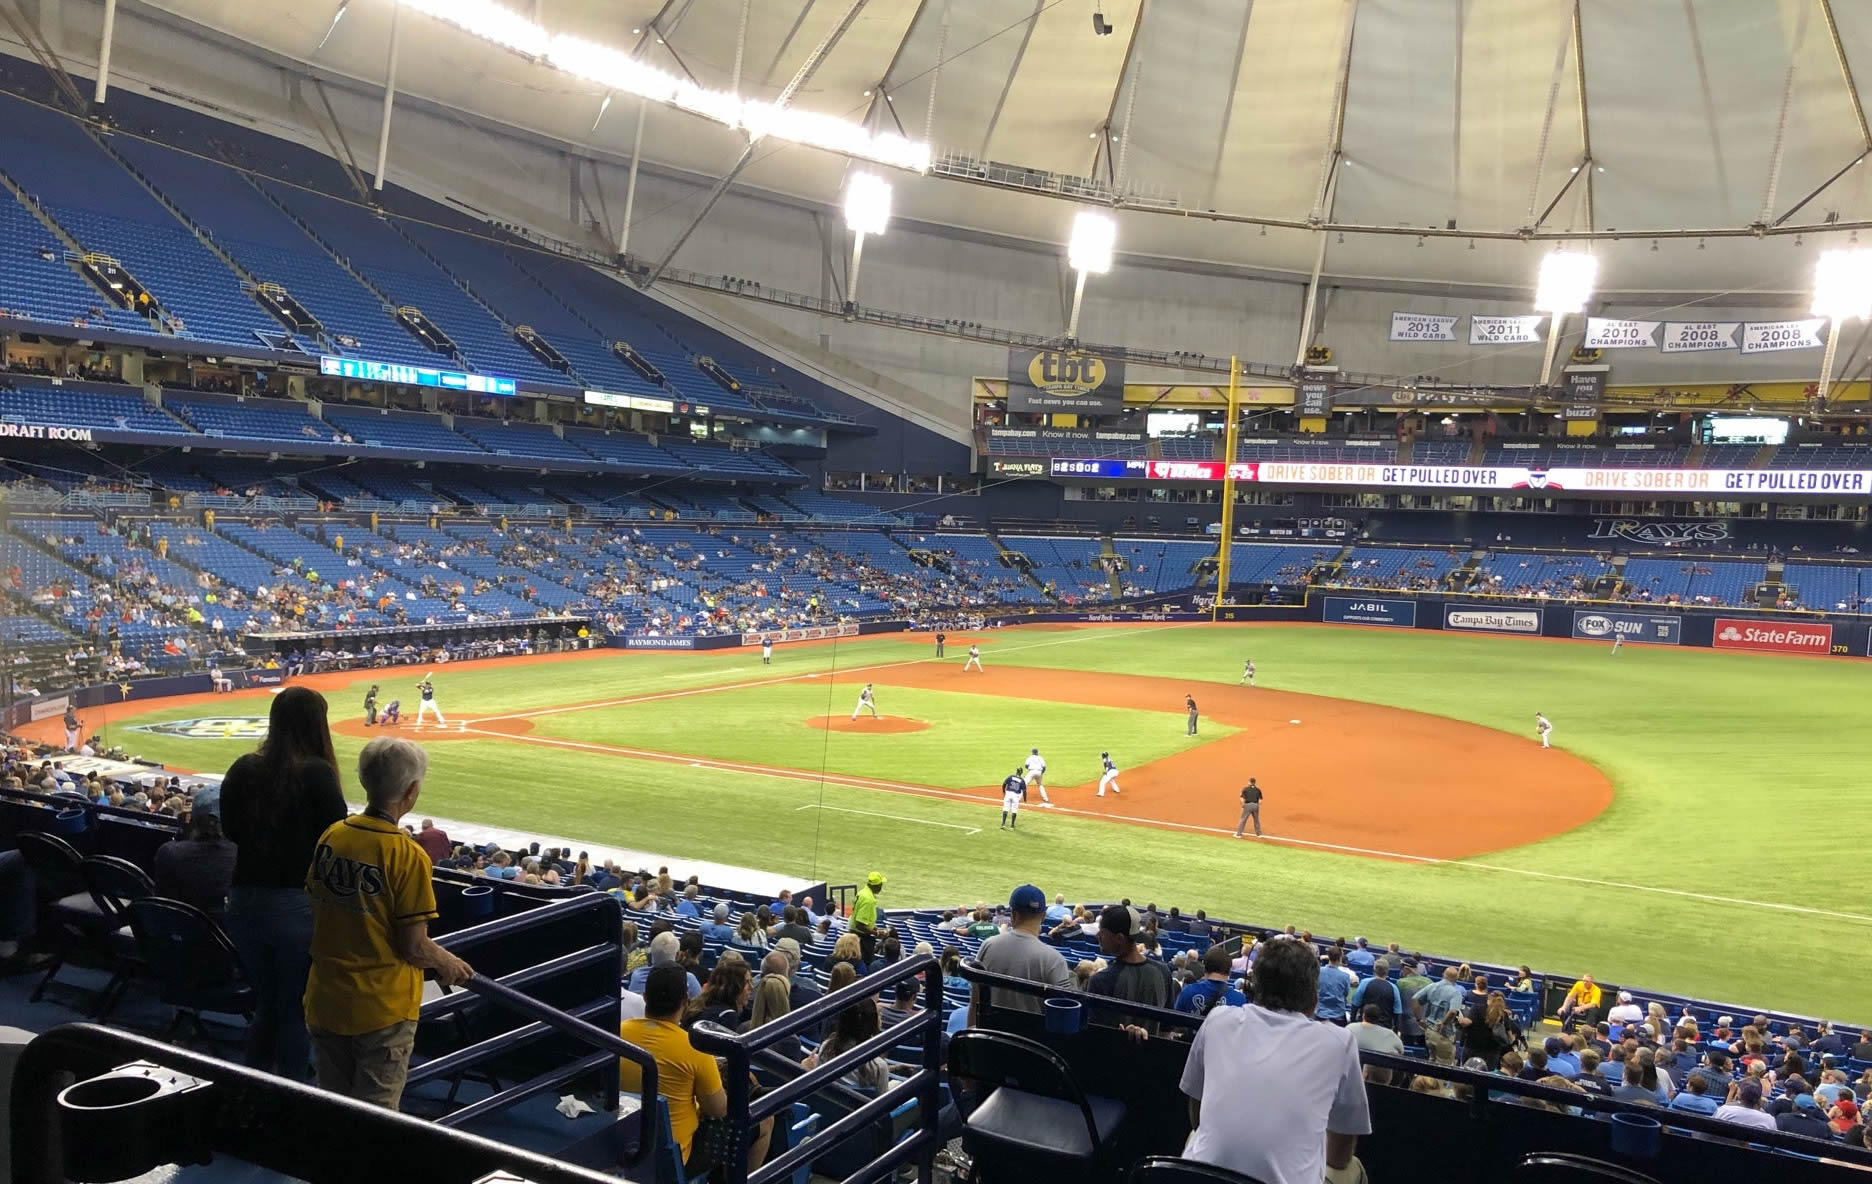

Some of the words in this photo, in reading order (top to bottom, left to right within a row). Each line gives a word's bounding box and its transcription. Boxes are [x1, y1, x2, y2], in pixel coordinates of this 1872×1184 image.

[1408, 322, 1440, 332] 2013
[1487, 325, 1521, 335] 2011
[1601, 328, 1639, 338] 2010
[1680, 331, 1718, 341] 2008
[1760, 330, 1801, 341] 2008
[1590, 338, 1647, 346] CHAMPIONS
[1668, 341, 1728, 349] CHAMPIONS
[1747, 340, 1812, 350] CHAMPIONS
[1040, 350, 1096, 384] tbt
[1570, 375, 1597, 384] Have
[1305, 392, 1323, 400] you
[1062, 399, 1075, 407] you
[1565, 408, 1597, 417] buzz?
[0, 423, 45, 438] DRAFT
[47, 426, 92, 441] ROOM
[991, 428, 1037, 438] tampabay.com
[1042, 430, 1065, 439] Know
[1065, 430, 1071, 439] it
[1096, 431, 1141, 441] tampabay.com
[1126, 461, 1145, 469] MPH
[1266, 464, 1305, 481] DRIVE
[1309, 466, 1353, 482] SOBER
[1357, 467, 1376, 482] OR
[1382, 467, 1407, 483] GET
[1409, 468, 1460, 484] PULLED
[1462, 470, 1498, 485] OVER
[1585, 471, 1628, 488] DRIVE
[1633, 471, 1684, 489] SOBER
[1688, 472, 1709, 489] OR
[1725, 472, 1754, 490] GET
[1757, 472, 1818, 490] PULLED
[1819, 473, 1864, 490] OVER
[1587, 518, 1730, 544] RAYS
[1191, 594, 1215, 605] Hard
[1349, 602, 1389, 613] JABIL
[1088, 613, 1101, 622] Hard
[1101, 613, 1114, 622] Rock
[1141, 613, 1153, 621] Hard
[1153, 613, 1166, 622] Rock
[1452, 613, 1484, 627] Tampa
[1484, 614, 1504, 628] Bay
[1505, 615, 1534, 627] Times
[1585, 619, 1605, 628] FOX
[1613, 620, 1643, 634] SUN
[628, 639, 665, 647] RAYMOND
[665, 639, 692, 648] JAMES
[1832, 645, 1848, 653] 370
[313, 843, 384, 897] RAYS
